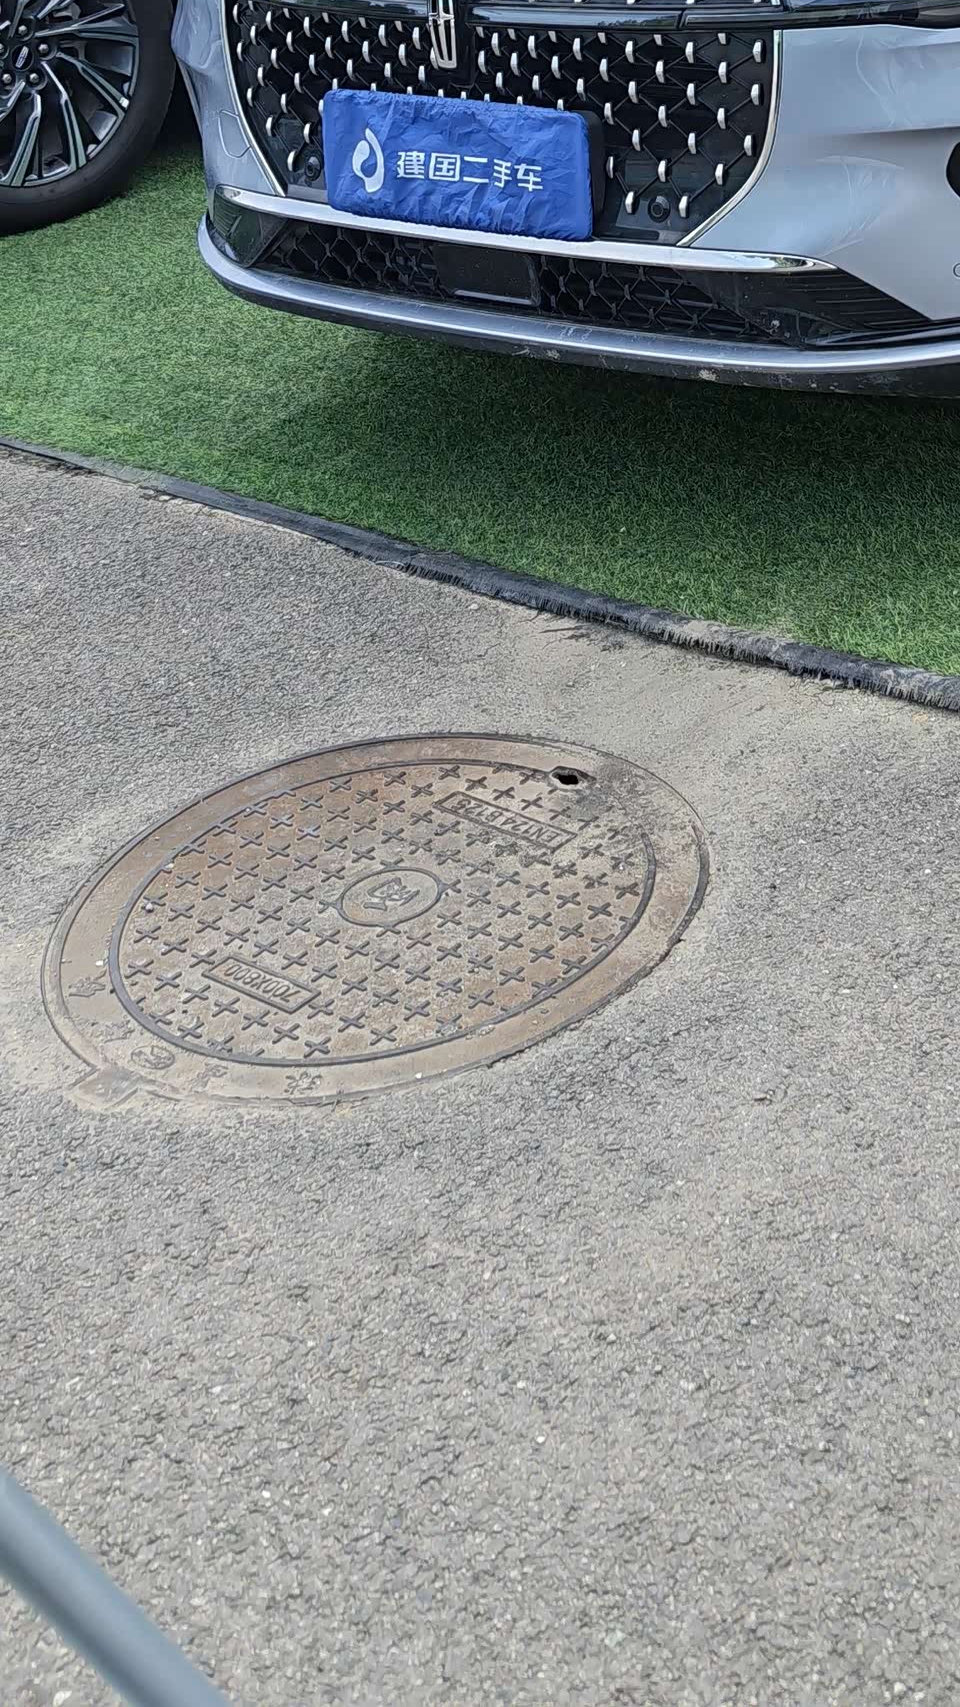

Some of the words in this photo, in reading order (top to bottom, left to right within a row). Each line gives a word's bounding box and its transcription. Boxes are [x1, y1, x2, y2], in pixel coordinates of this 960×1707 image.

[396, 150, 544, 192] 建国二手车
